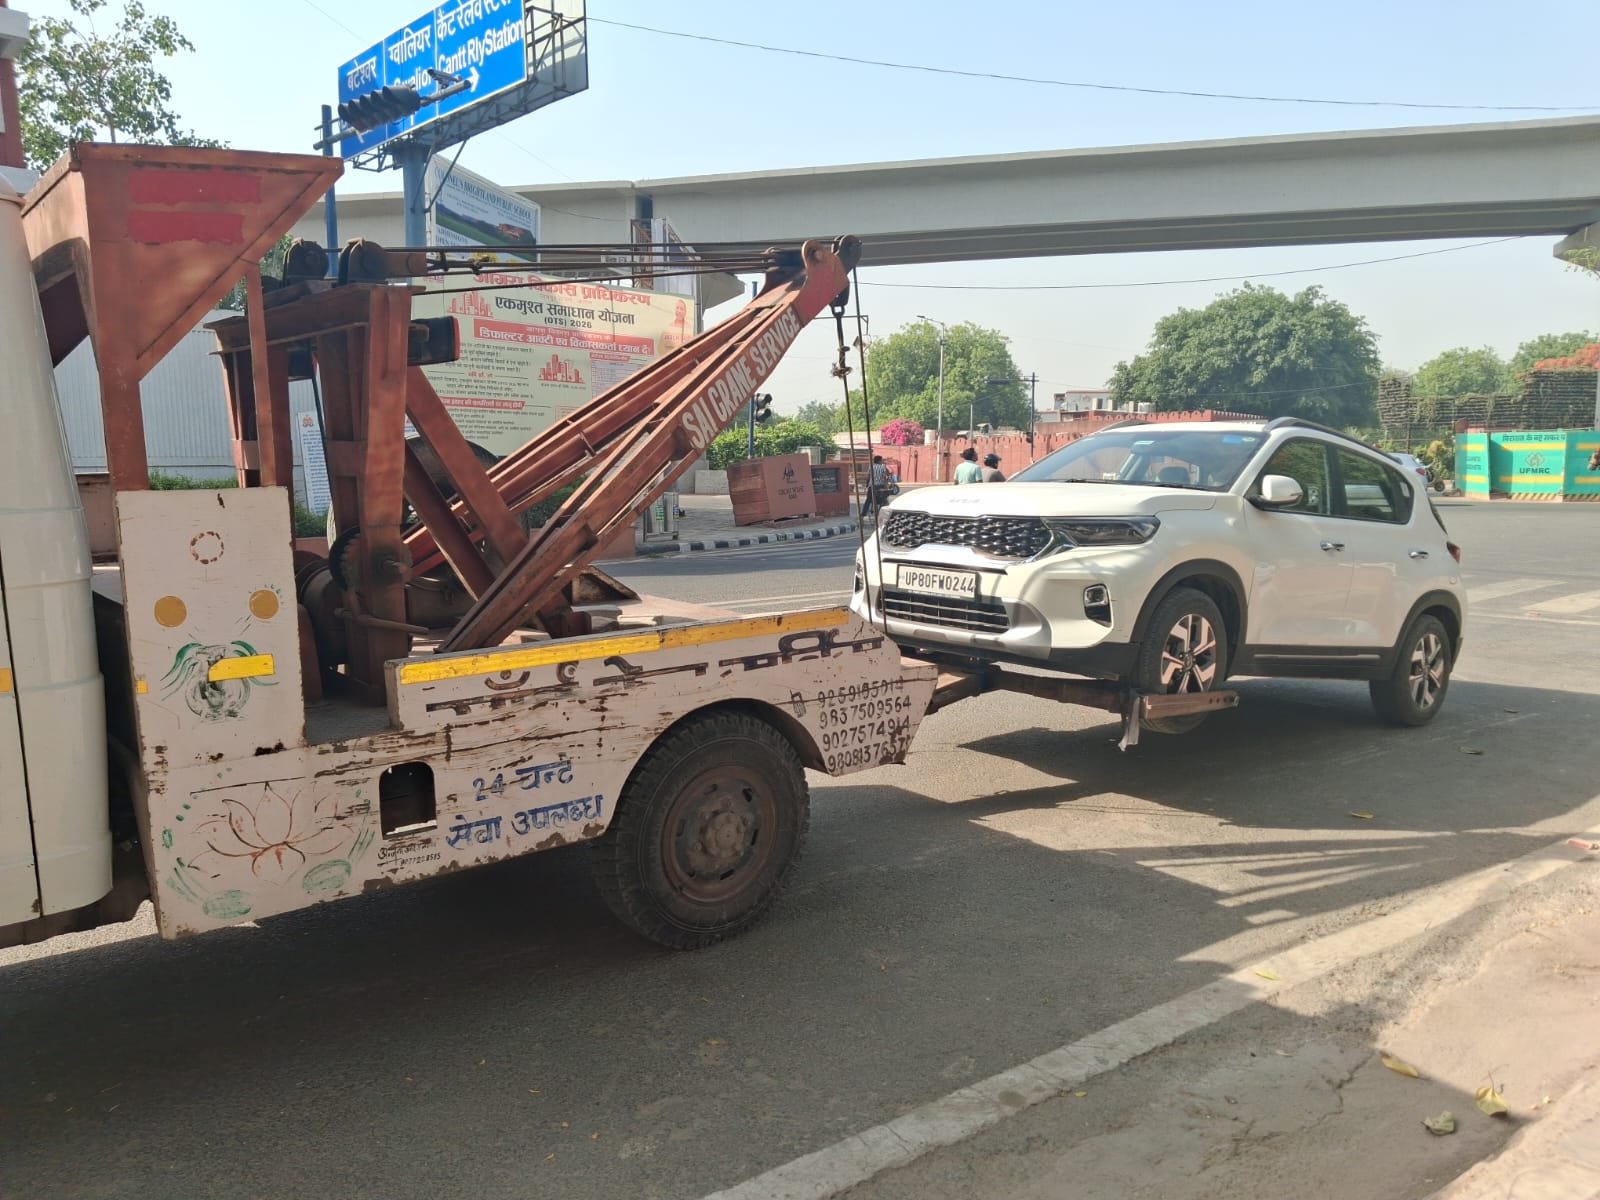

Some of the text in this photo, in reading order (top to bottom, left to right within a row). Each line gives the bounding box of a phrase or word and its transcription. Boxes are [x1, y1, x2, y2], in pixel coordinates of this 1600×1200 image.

[388, 24, 431, 65] ग्वालियर
[438, 45, 467, 74] Cantt
[347, 56, 377, 93] बटेश्वर
[580, 284, 651, 306] प्राधिकरण
[495, 296, 543, 315] एकमुश्त
[546, 302, 595, 320] समाधान
[599, 307, 635, 325] योजना
[544, 317, 592, 328] (OTS) 2026
[682, 306, 800, 449] SAI CRANE SERVICE
[905, 571, 975, 593] UP80FW0244
[819, 695, 912, 729] 9837509564
[472, 773, 506, 801] 24
[446, 814, 502, 850] सेवा
